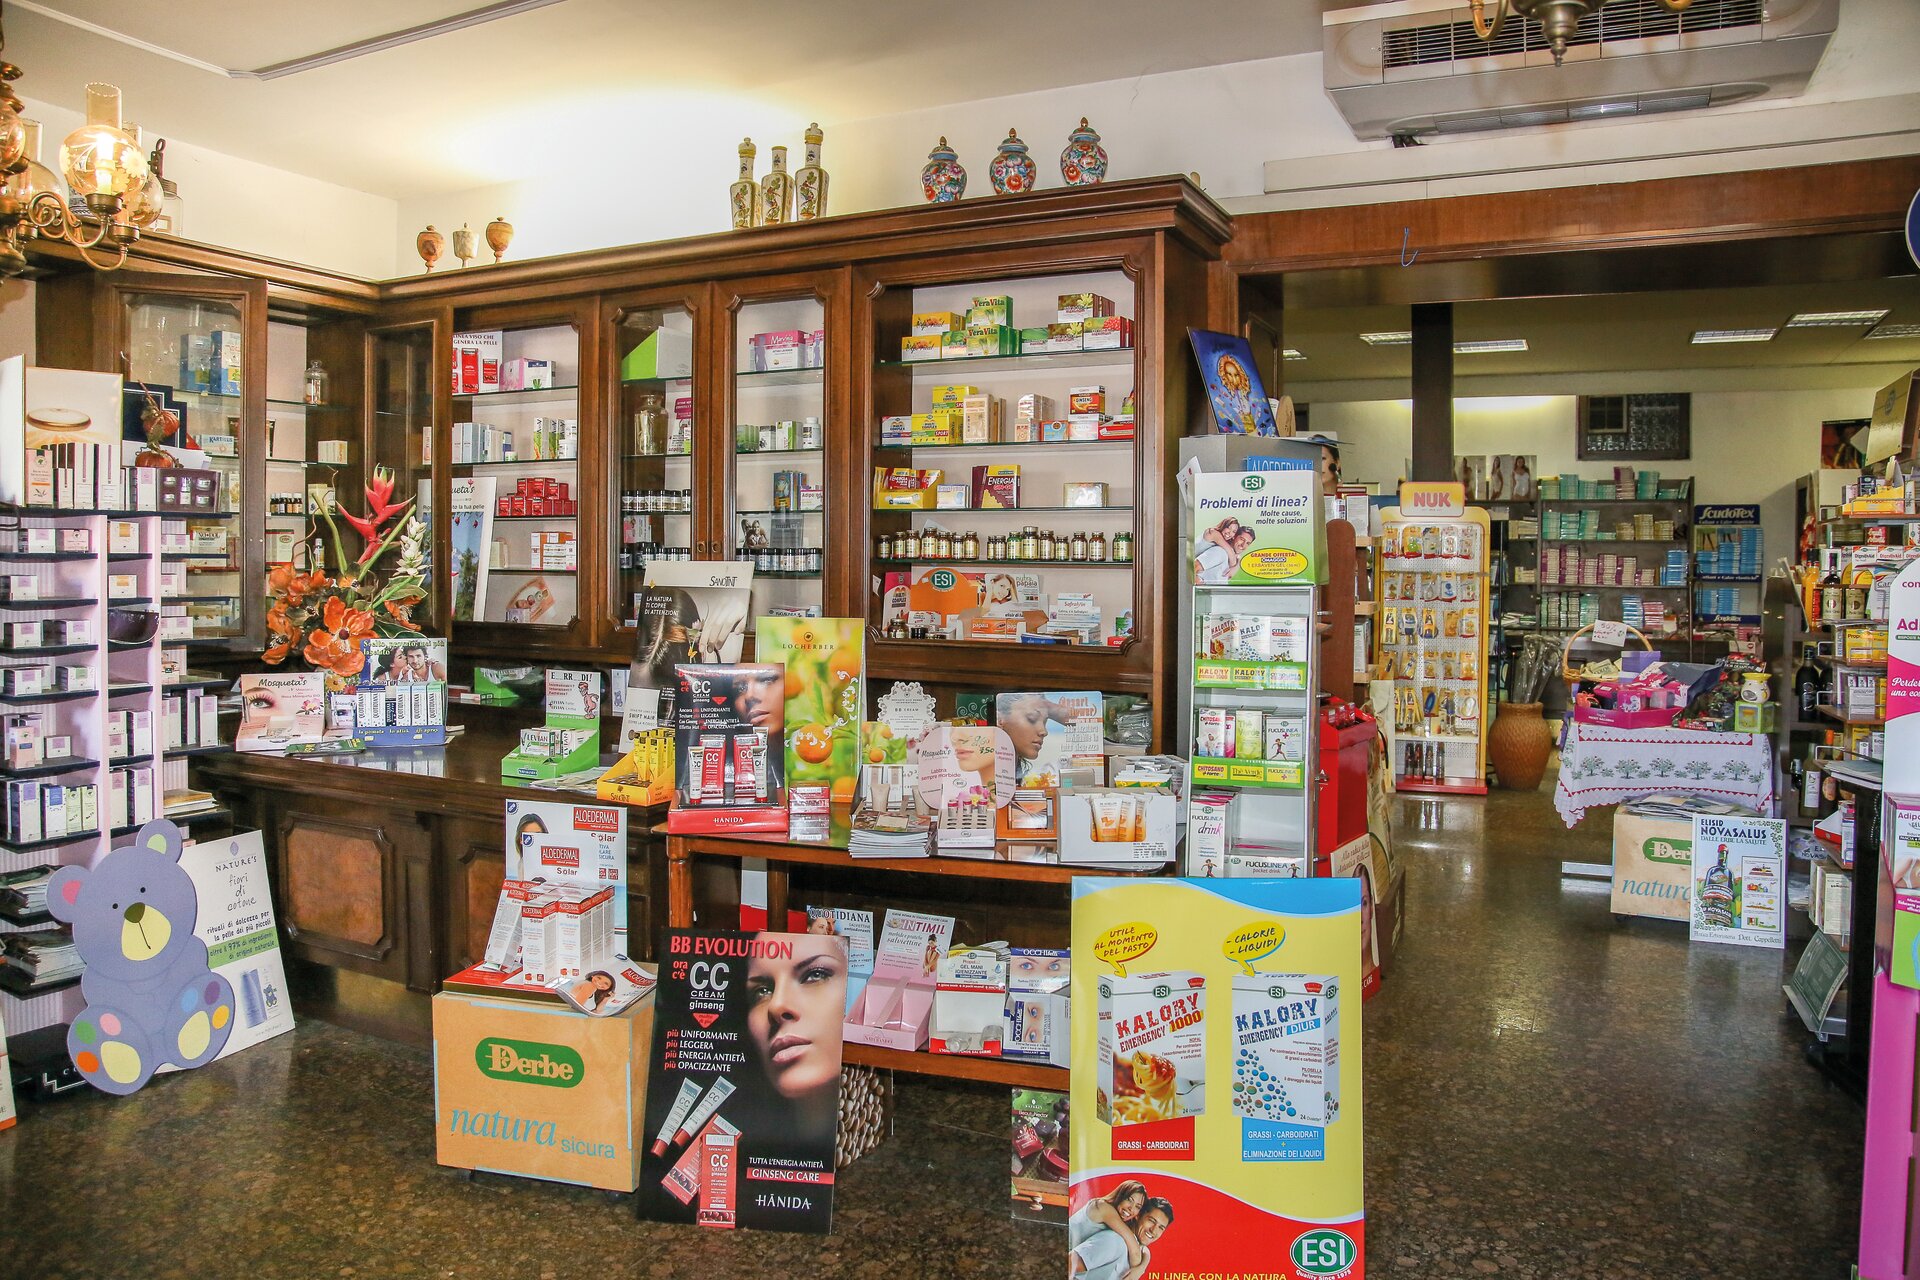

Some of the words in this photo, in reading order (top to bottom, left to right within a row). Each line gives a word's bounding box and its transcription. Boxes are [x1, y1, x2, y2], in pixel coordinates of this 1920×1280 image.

[988, 477, 1014, 486] ENERGIA
[1244, 478, 1262, 488] ESI
[1200, 496, 1252, 509] Problemi
[1256, 496, 1268, 508] di
[1272, 496, 1308, 508] linea?
[1414, 492, 1451, 508] NUK
[934, 573, 952, 586] ESI
[258, 678, 307, 688] Mosqueta's
[692, 681, 712, 694] CC
[706, 753, 719, 762] CC
[576, 810, 618, 826] ALOEDERMAL
[1198, 822, 1222, 836] drink
[1700, 826, 1768, 839] NOVASALUS
[542, 848, 579, 860] ALOEDERMAL
[215, 856, 258, 872] NATURE'S
[1245, 860, 1288, 868] FUCUSLINEA
[556, 867, 578, 876] Solar
[228, 872, 248, 886] fiori
[235, 886, 246, 898] di
[227, 898, 257, 912] cotone
[810, 908, 870, 922] QUOTIDIANA
[206, 924, 225, 935] rituali
[236, 914, 259, 926] dolcezza
[222, 930, 235, 941] pelle
[255, 918, 272, 930] piccoli
[900, 920, 946, 934] INTIMIL
[1109, 926, 1136, 938] UTILE
[1234, 927, 1276, 944] CALORIE
[228, 942, 241, 952] 97%
[1094, 942, 1106, 951] AL
[1107, 931, 1155, 948] MOMENTO
[1238, 938, 1278, 953] LIQUIDI
[670, 936, 692, 954] BB
[694, 937, 794, 960] EVOLUTION
[1103, 947, 1122, 958] DEL
[1122, 942, 1150, 954] PASTO
[673, 960, 688, 970] ora
[672, 968, 686, 980] c'è
[690, 961, 730, 992] CC
[690, 990, 726, 999] CREAM
[1155, 988, 1168, 997] ESI
[1270, 988, 1284, 997] ESI
[1328, 986, 1336, 998] ESI
[689, 1000, 725, 1012] ginseng
[1116, 992, 1198, 1039] KALORY
[1235, 998, 1318, 1032] KALORY
[667, 1030, 678, 1040] più
[680, 1030, 738, 1042] UNIFORMANTE
[1120, 1026, 1166, 1052] EMERGENCY
[1170, 1010, 1202, 1032] 1000
[1239, 1026, 1284, 1046] EMERGENCY
[1290, 1020, 1316, 1034] DIUR
[666, 1040, 678, 1050] più
[680, 1040, 714, 1050] LEGGERA
[485, 1044, 574, 1081] Derbe
[665, 1050, 678, 1061] più
[678, 1050, 712, 1062] ENERGIA
[713, 1052, 746, 1062] ANTIETÀ
[664, 1061, 676, 1072] più
[678, 1062, 732, 1072] OPACIZZANTE
[450, 1107, 558, 1147] natura
[561, 1137, 616, 1159] sicura
[1248, 1130, 1272, 1139] GRASSI
[1276, 1130, 1319, 1140] CARBOIDRATI
[1118, 1140, 1142, 1150] GRASSI
[1146, 1140, 1190, 1150] CARBOIDRATI
[1243, 1150, 1288, 1158] ELIMINAZIONE
[1288, 1150, 1298, 1158] DEI
[1299, 1149, 1322, 1158] LIQUIDI
[710, 1154, 729, 1168] CC
[750, 1157, 768, 1165] TUTTA
[769, 1158, 798, 1167] L'ENERGIA
[798, 1160, 824, 1168] ANTIETÀ
[752, 1168, 794, 1181] GINSENG
[796, 1172, 820, 1182] CARE
[1302, 1239, 1346, 1268] ESI
[1296, 1268, 1319, 1280] Quality
